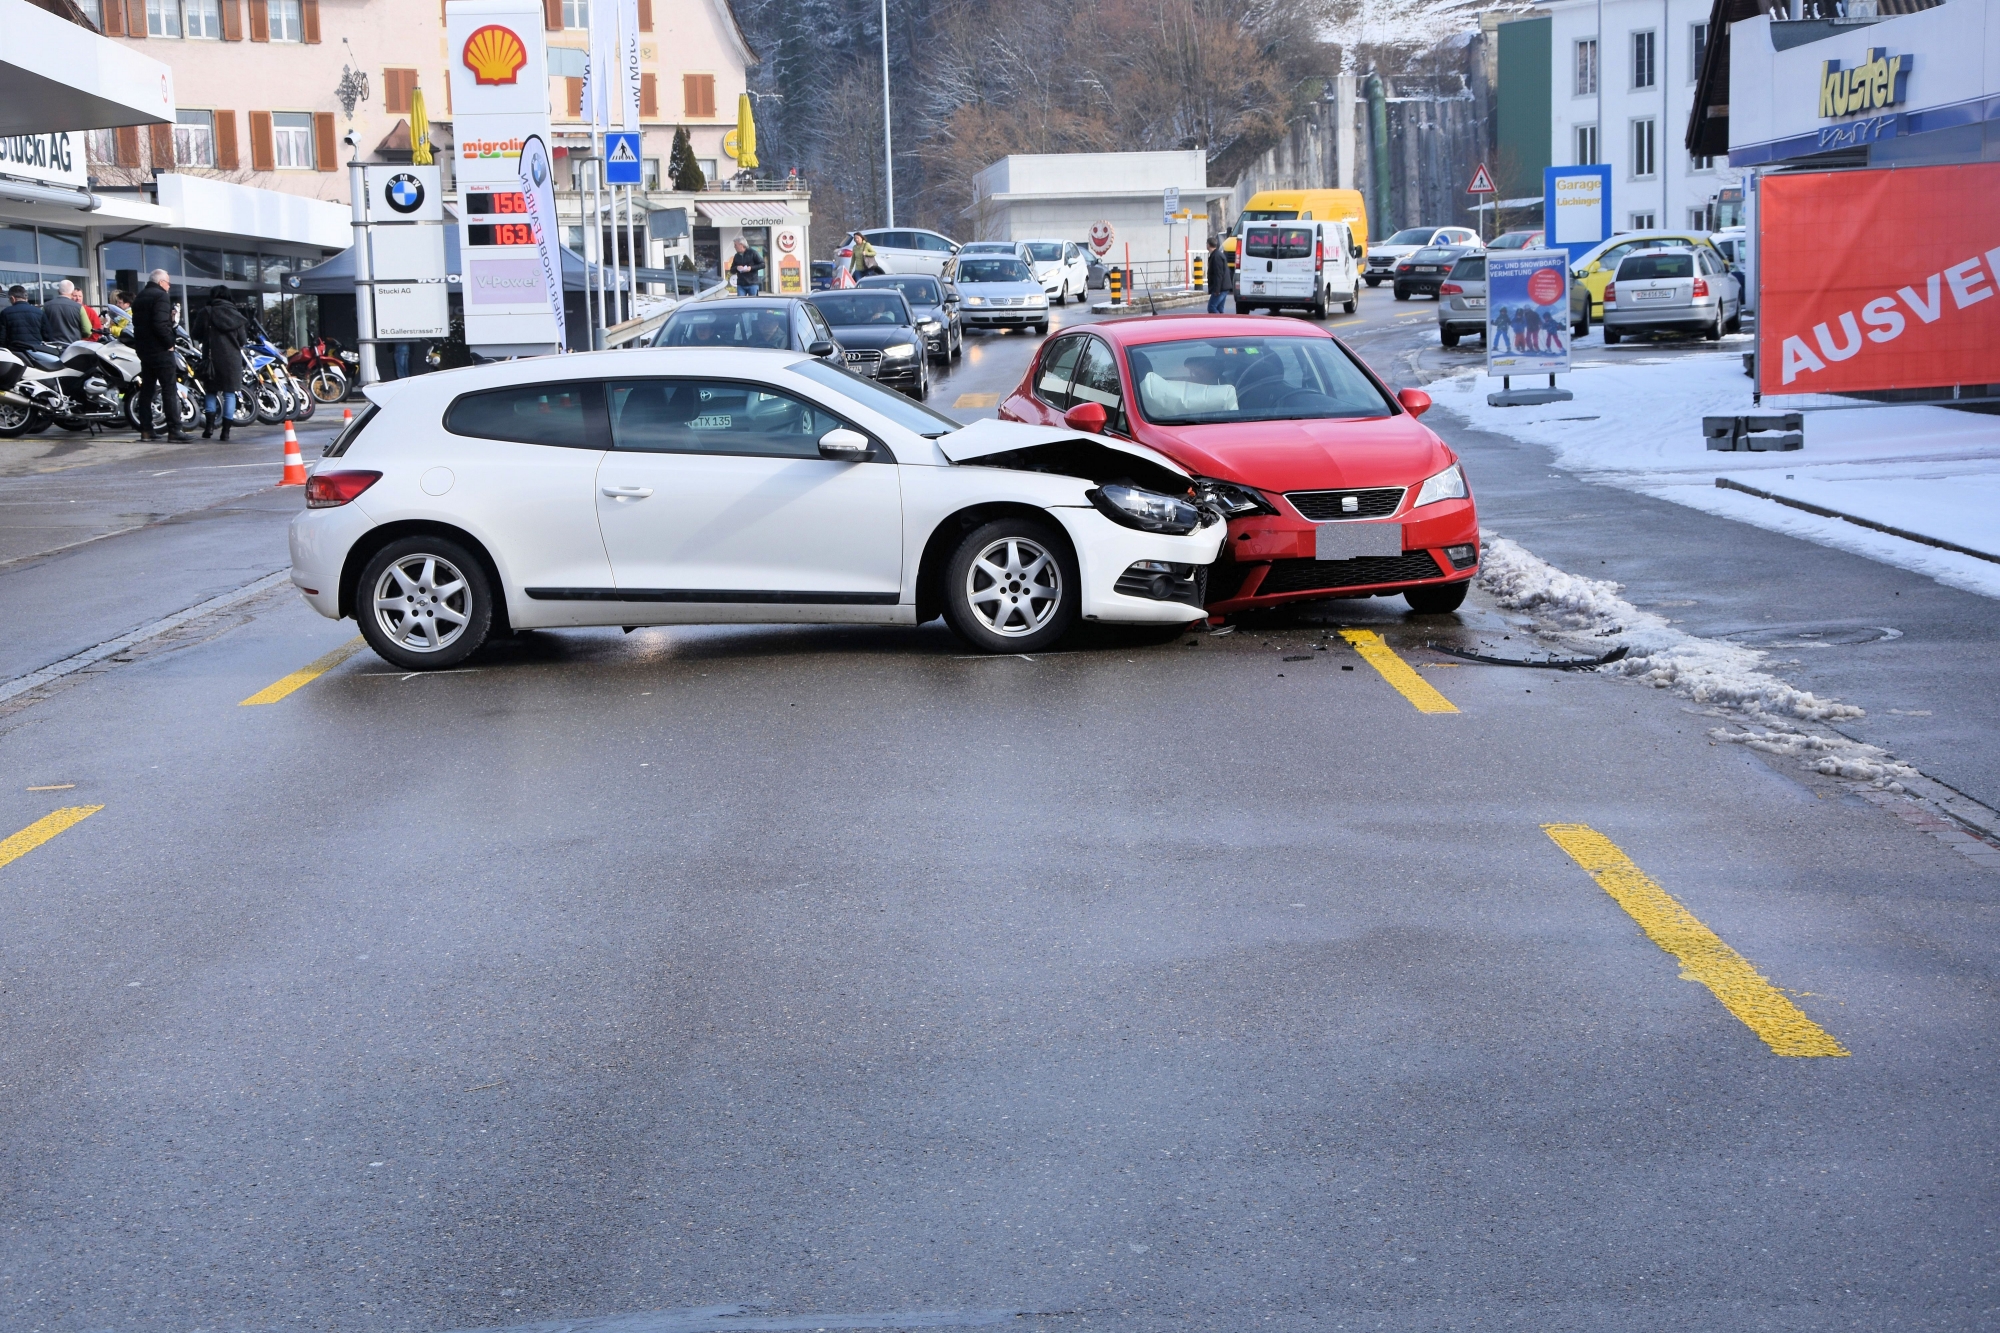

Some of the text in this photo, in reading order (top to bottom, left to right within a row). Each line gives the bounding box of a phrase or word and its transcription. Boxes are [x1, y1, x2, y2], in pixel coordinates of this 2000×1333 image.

[1818, 48, 1906, 118] kuster
[49, 132, 72, 172] AG
[1556, 180, 1601, 191] Garage
[1556, 197, 1601, 207] Lüchinger
[741, 217, 784, 225] Conditorei
[1520, 259, 1564, 268] SNOWBOARD-
[1489, 269, 1532, 277] VERMIETUNG
[476, 276, 539, 288] V-Power
[699, 417, 711, 426] TX
[713, 417, 731, 426] 135
